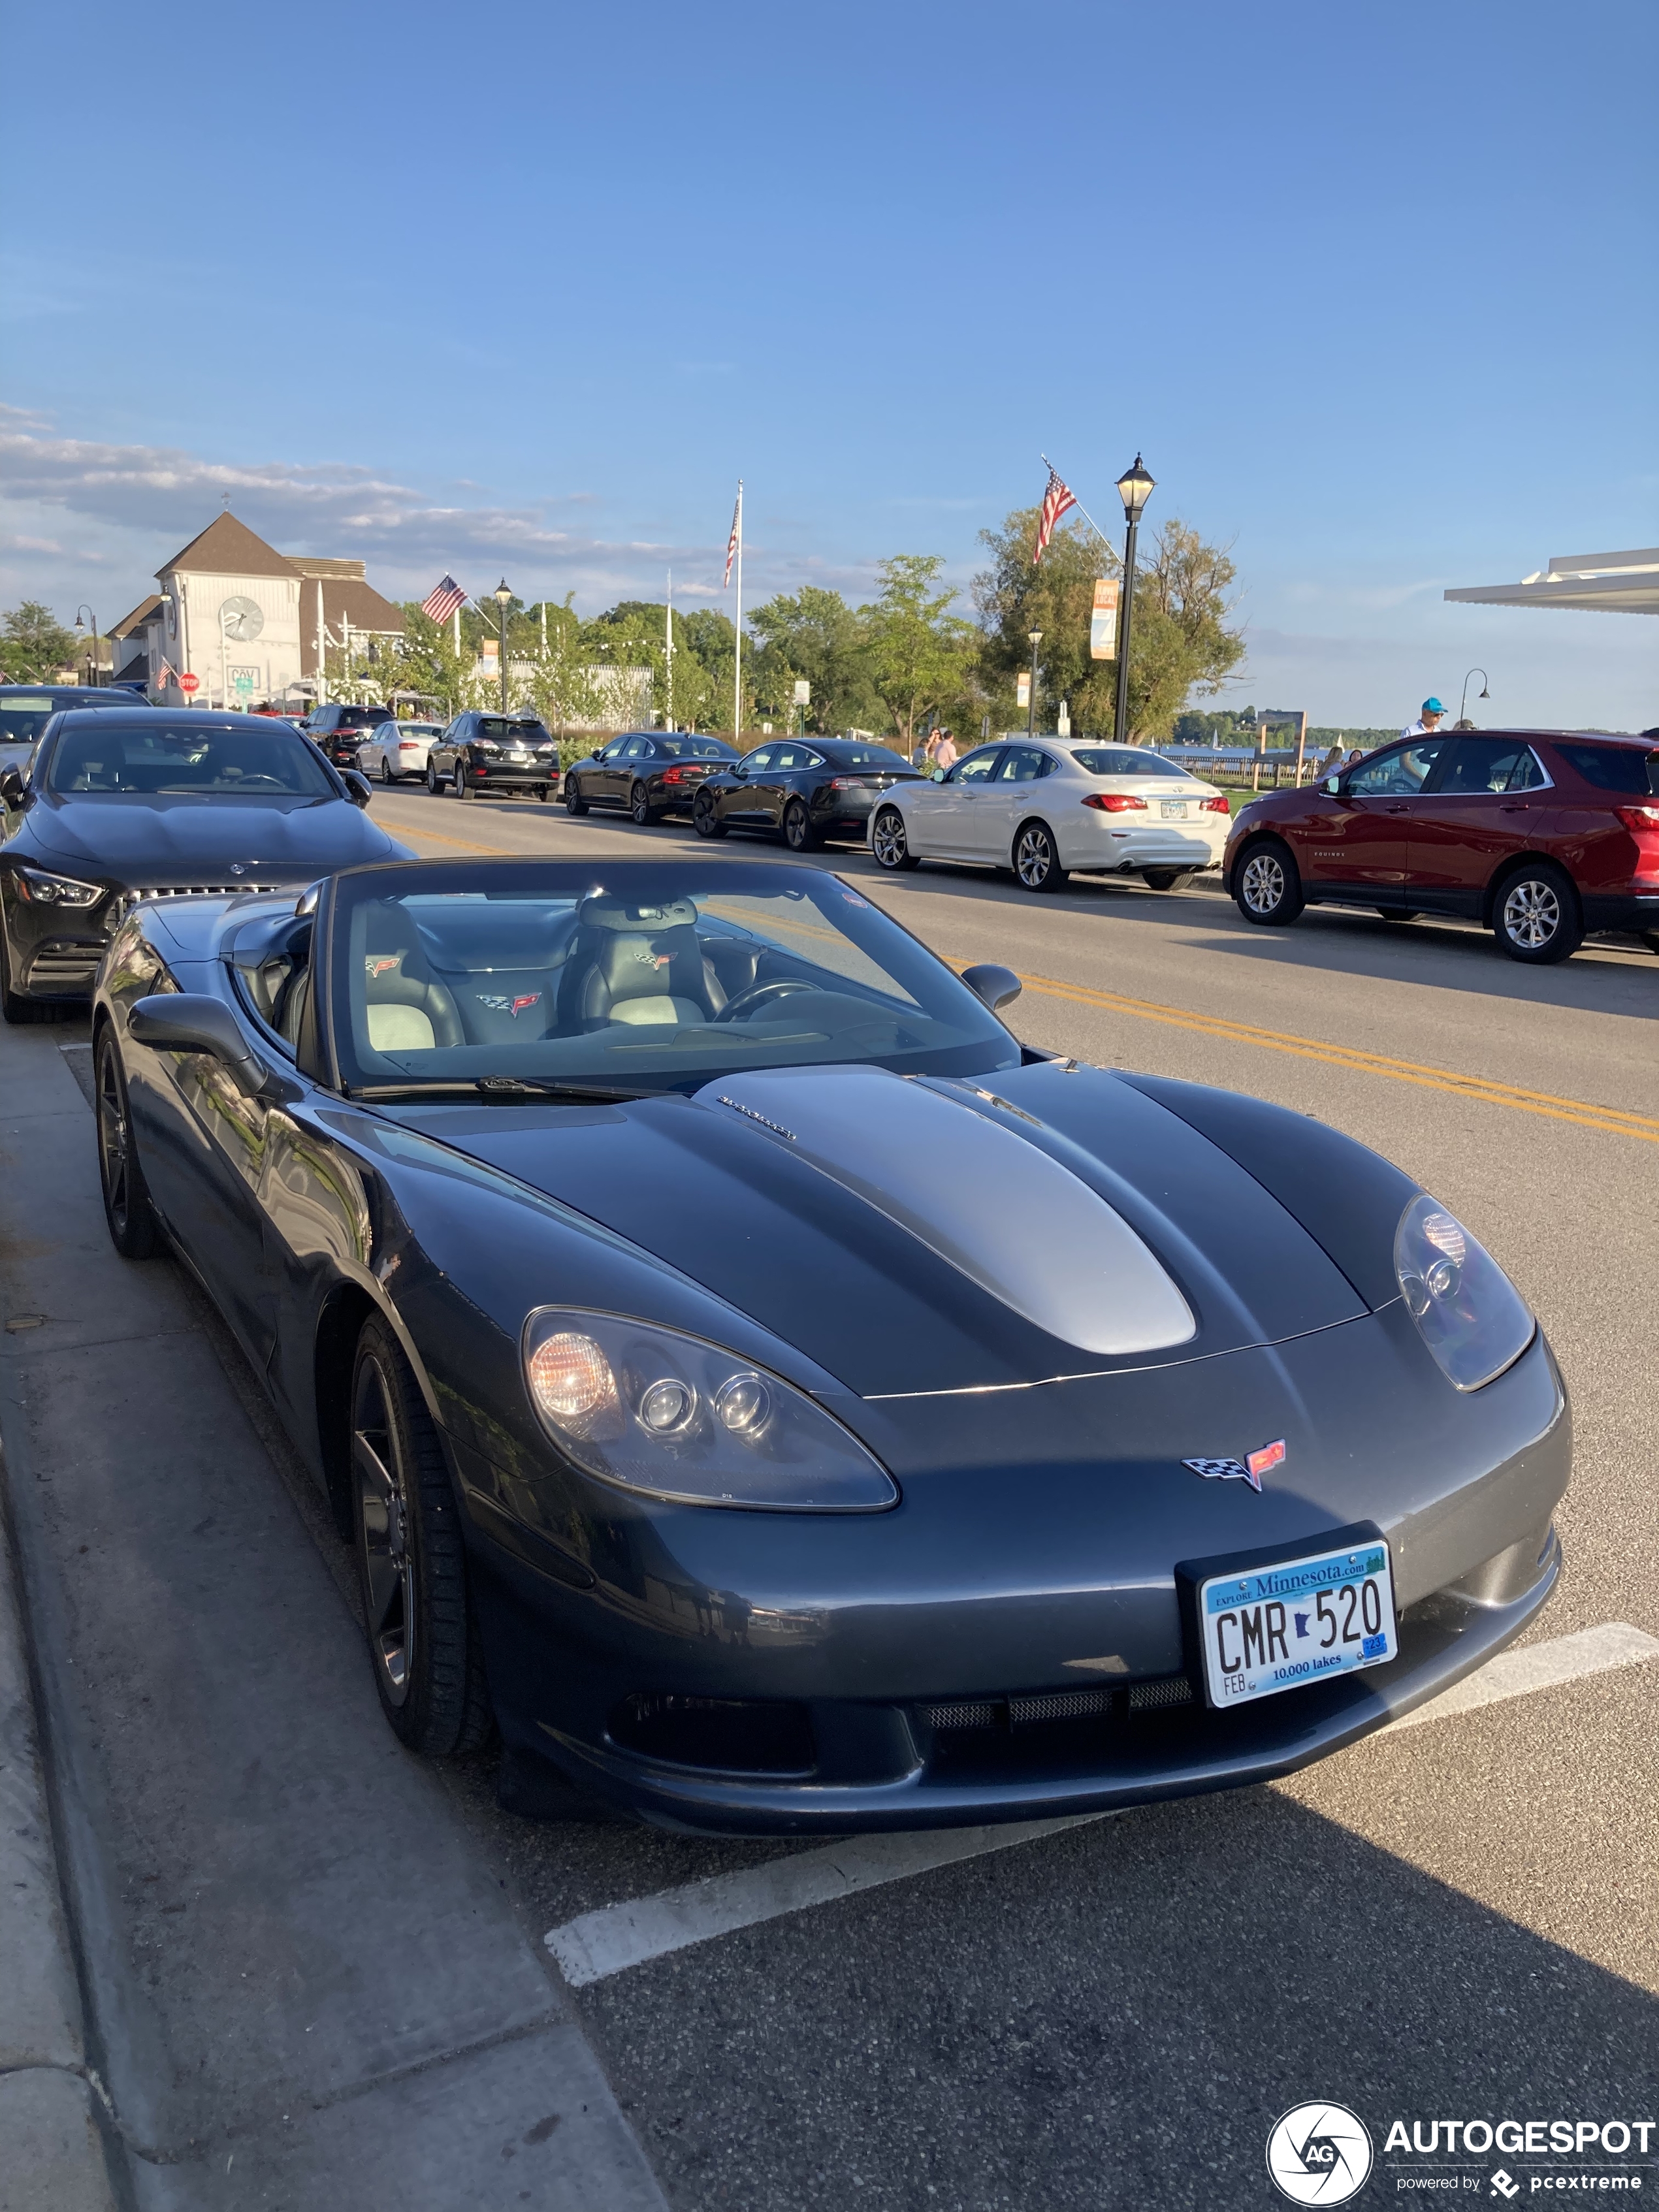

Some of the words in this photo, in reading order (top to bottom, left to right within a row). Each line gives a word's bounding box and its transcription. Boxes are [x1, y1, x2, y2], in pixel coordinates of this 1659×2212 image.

[1096, 596, 1115, 605] LOCAL
[716, 1095, 797, 1141] SUPERCHARGED
[1216, 1592, 1252, 1606] EXPLORE
[1255, 1564, 1364, 1597] Minnesota.com
[1217, 1601, 1289, 1674] CMR
[1316, 1579, 1381, 1648] 520
[1369, 1637, 1381, 1649] 23
[1274, 1662, 1310, 1680] 10,000
[1313, 1655, 1342, 1670] lakes
[1223, 1674, 1246, 1695] FEB
